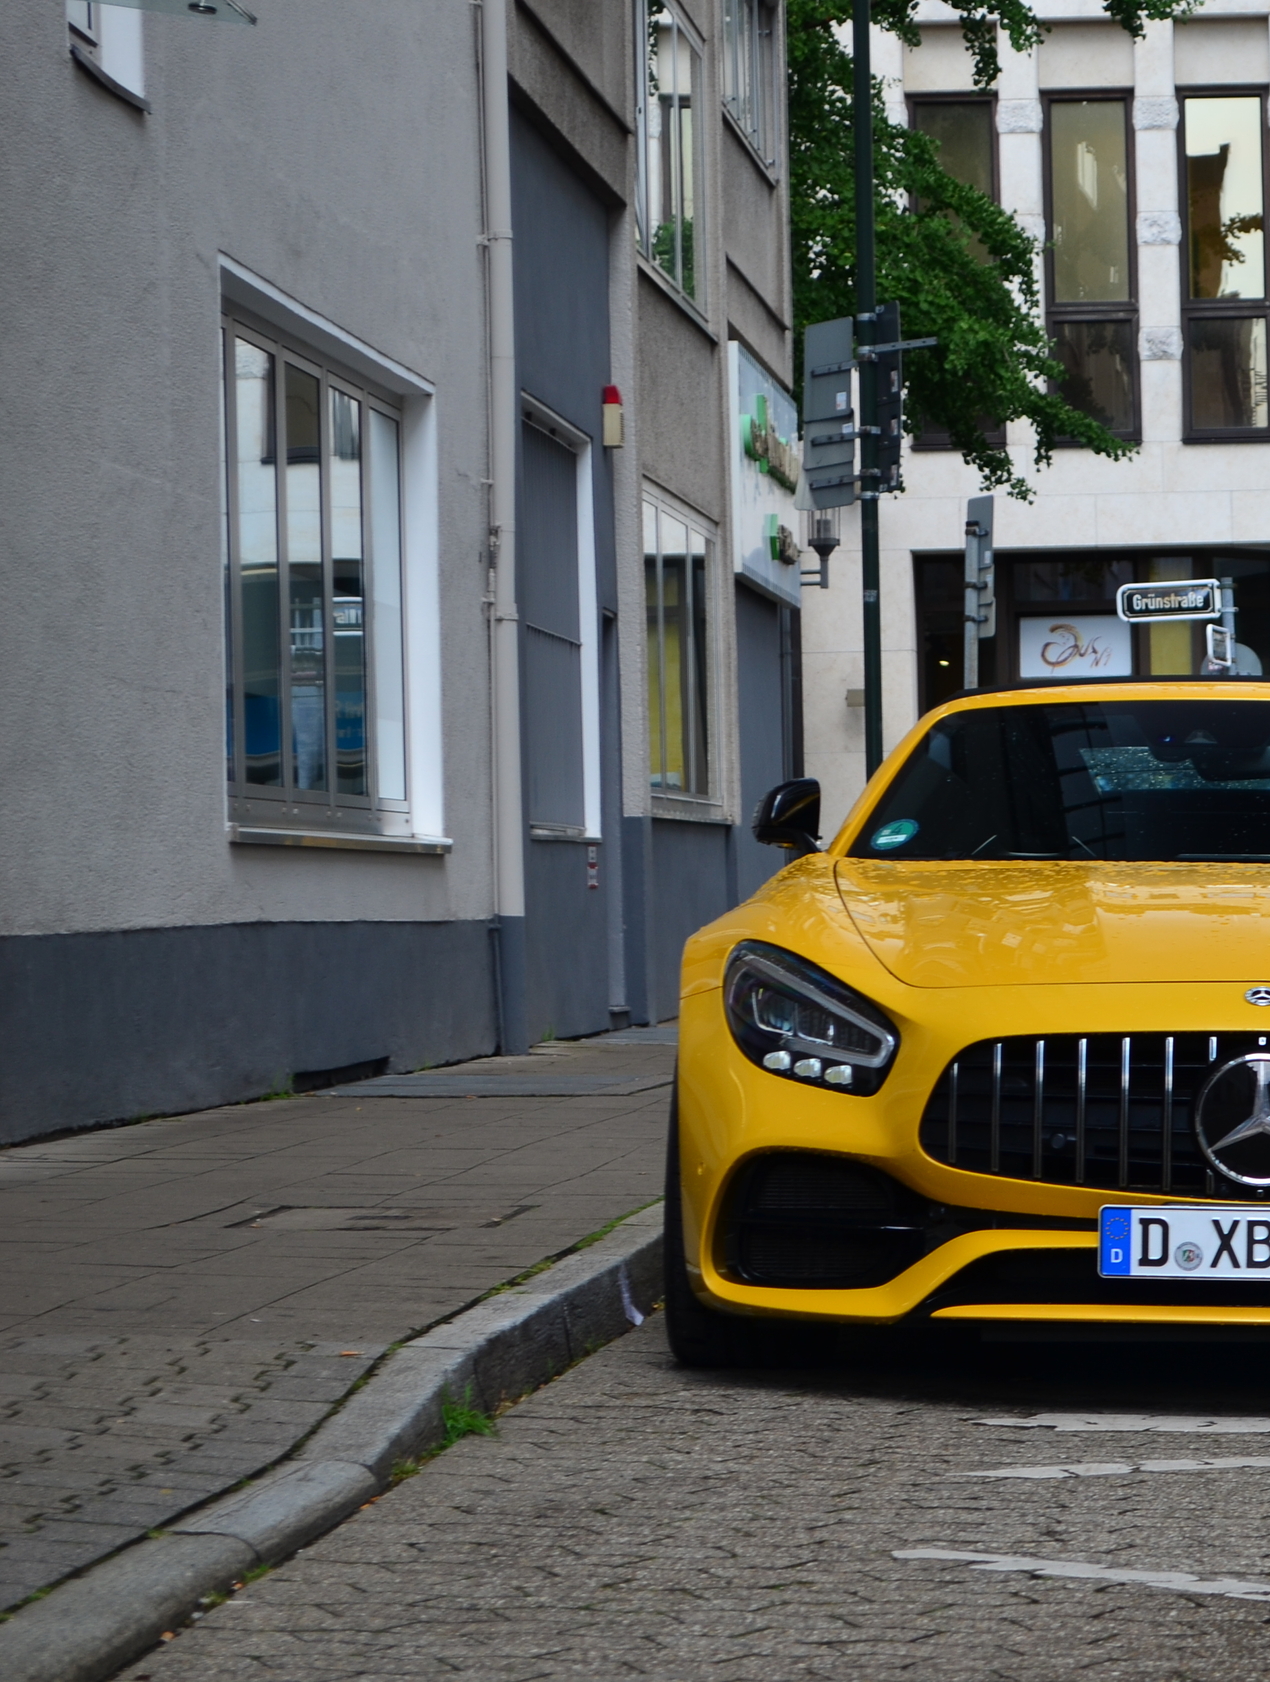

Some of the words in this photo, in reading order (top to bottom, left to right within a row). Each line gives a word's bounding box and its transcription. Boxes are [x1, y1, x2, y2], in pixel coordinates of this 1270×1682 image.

[1132, 591, 1204, 611] Grünstraße
[1138, 1217, 1169, 1267] D
[1110, 1248, 1123, 1263] D
